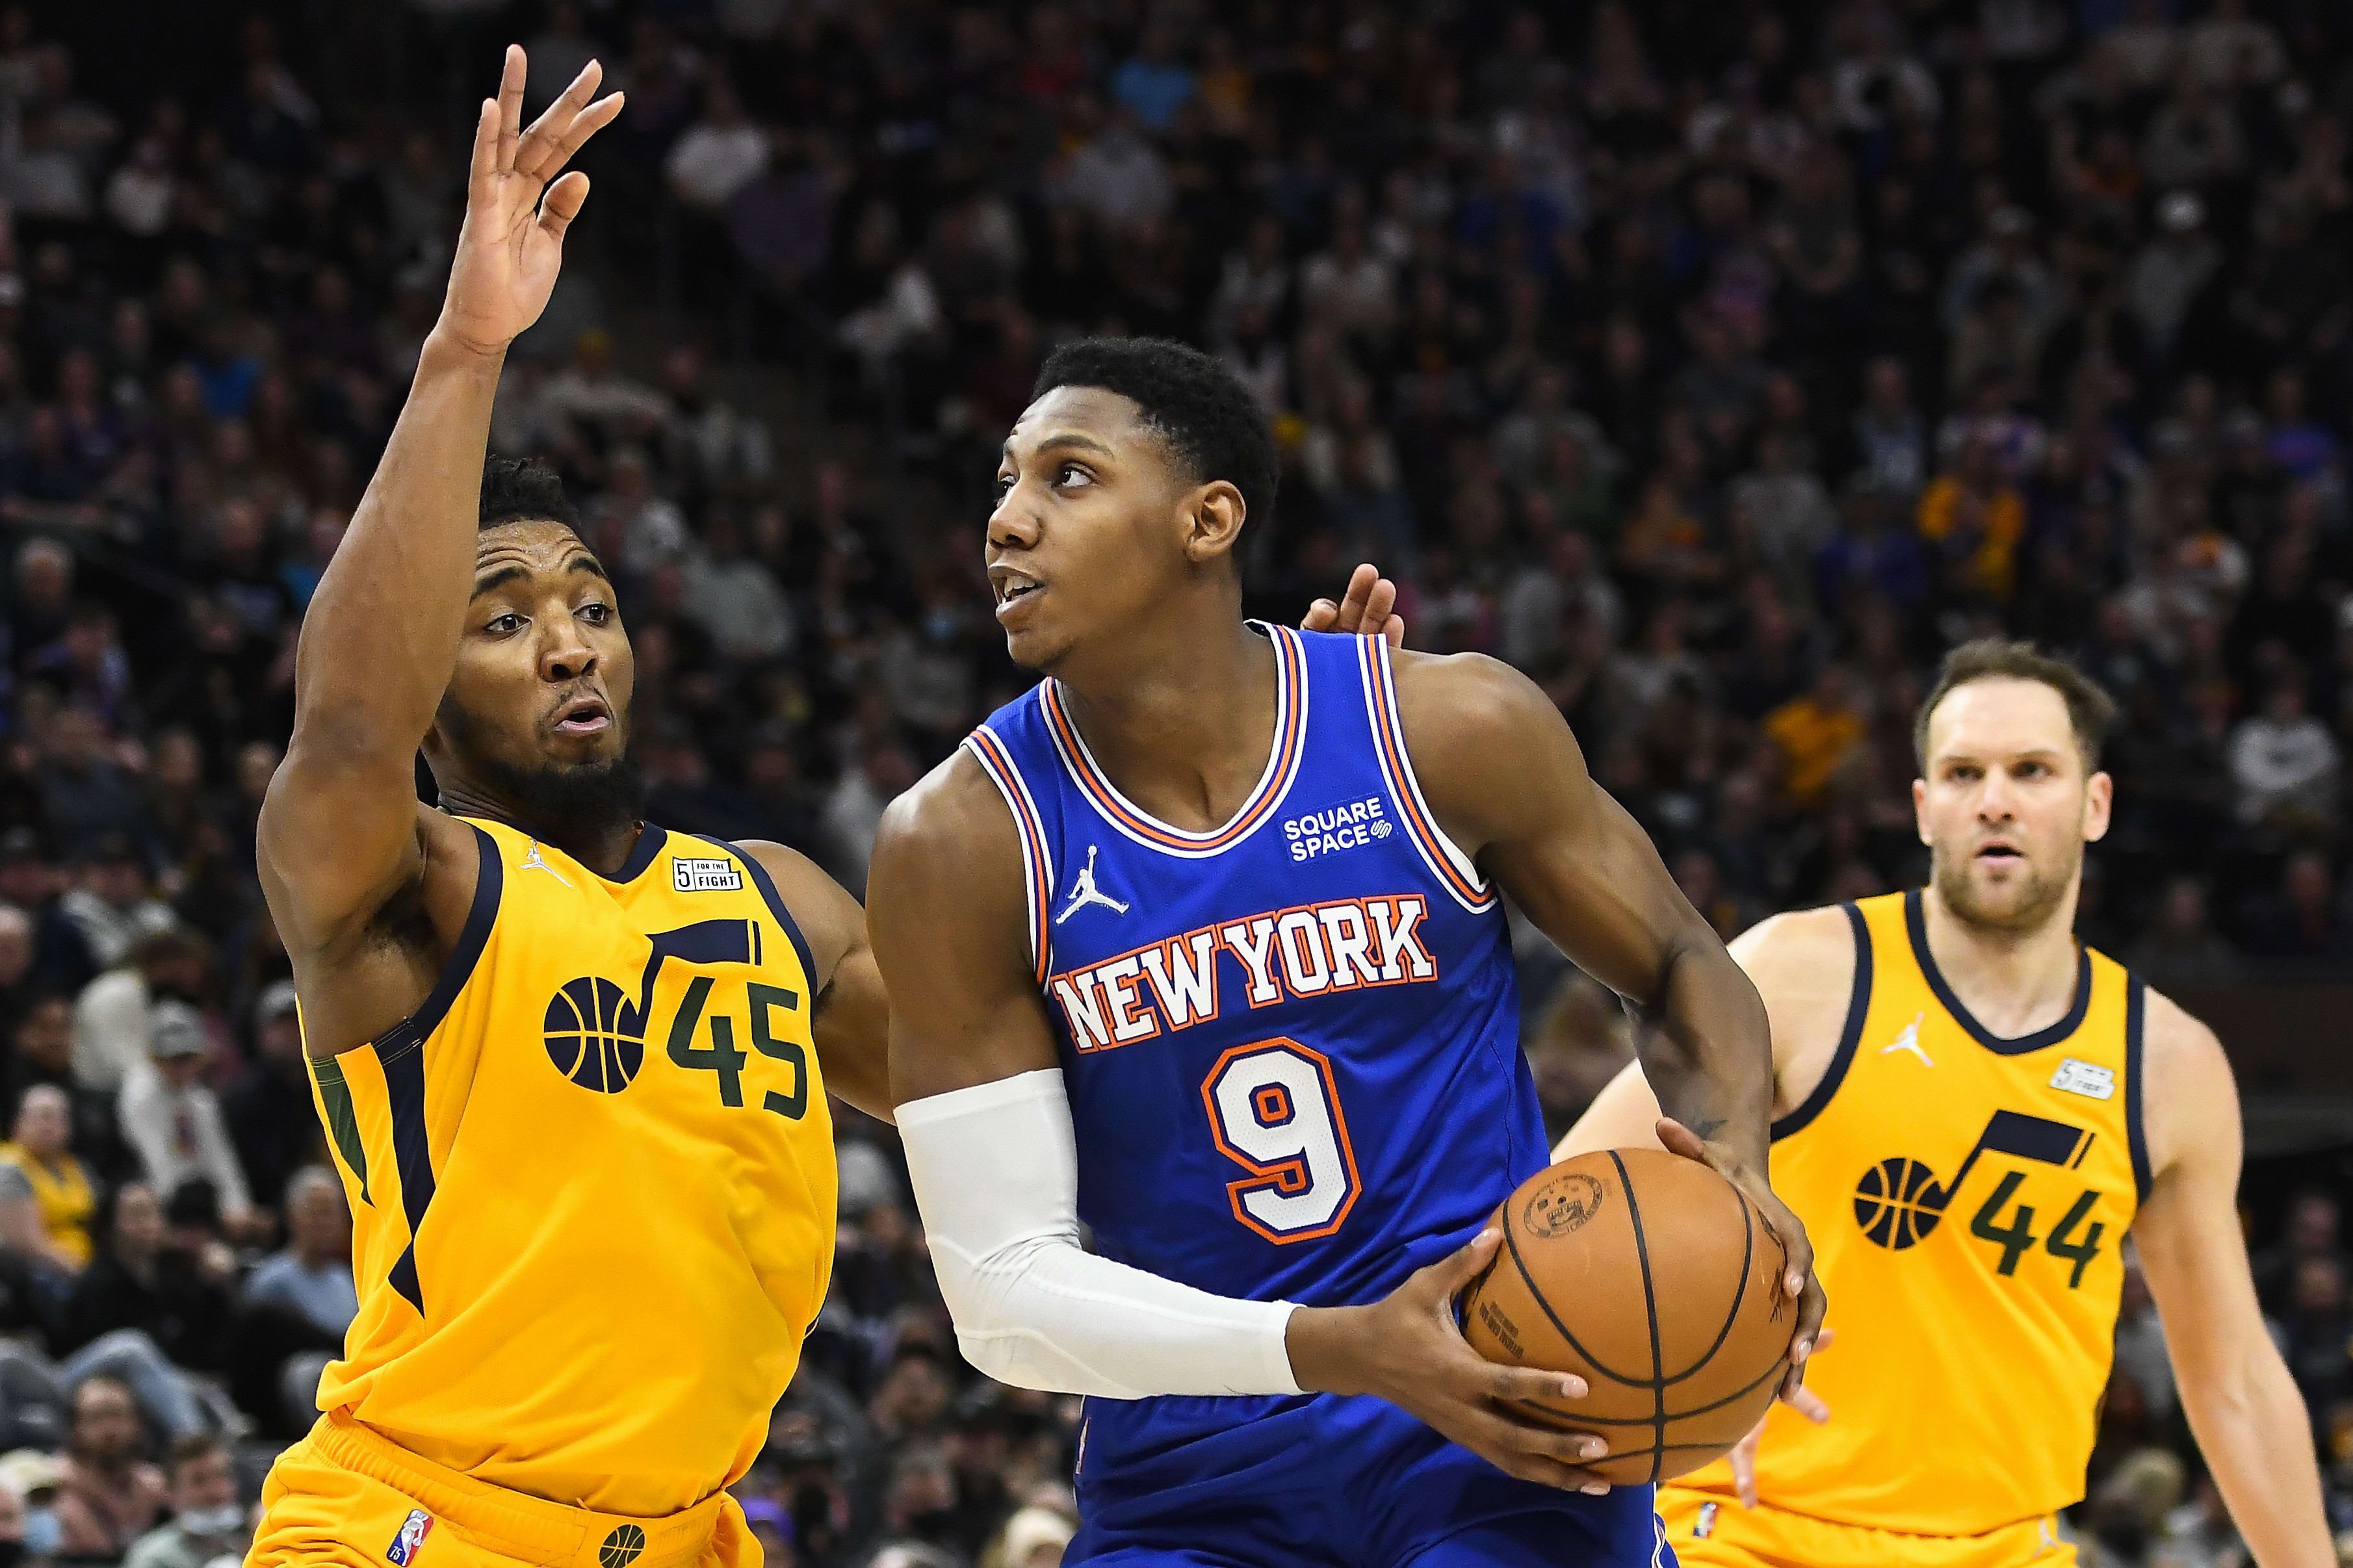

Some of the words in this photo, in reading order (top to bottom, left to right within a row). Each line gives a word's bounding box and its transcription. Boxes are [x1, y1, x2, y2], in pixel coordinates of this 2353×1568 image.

[1284, 797, 1384, 840] SQUARE
[1290, 824, 1370, 862] SPACE
[677, 863, 690, 888] 5
[699, 876, 734, 886] FIGHT
[1050, 925, 1219, 1054] NEW
[1221, 893, 1438, 1009] YORK
[666, 976, 807, 1120] 45
[1201, 1036, 1362, 1245] 9
[1970, 1170, 2105, 1289] 44
[389, 1546, 403, 1560] 75
